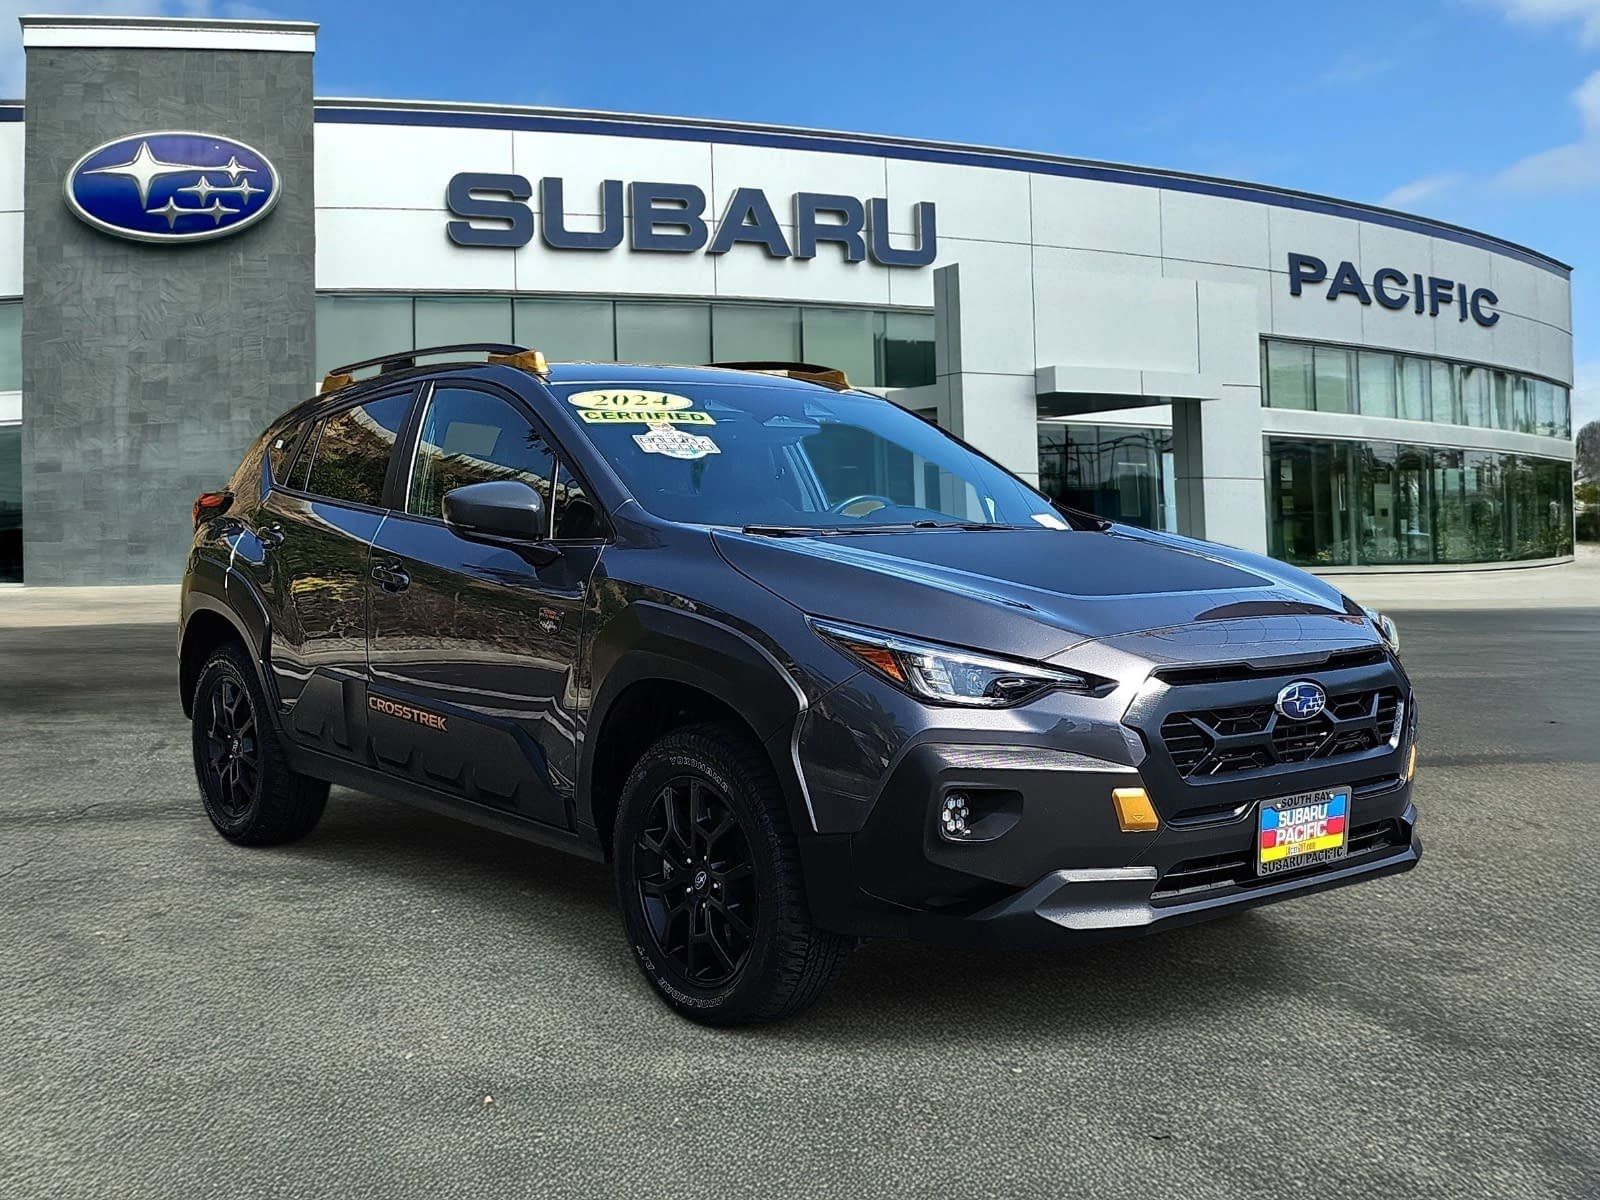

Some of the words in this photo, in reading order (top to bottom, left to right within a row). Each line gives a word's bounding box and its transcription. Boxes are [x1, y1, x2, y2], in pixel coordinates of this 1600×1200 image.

[446, 171, 937, 267] SUBARU
[1288, 252, 1500, 327] PACIFIC
[594, 394, 669, 407] 2024
[584, 411, 706, 422] CERTIFIED
[368, 696, 448, 732] CROSSTREK
[1281, 795, 1313, 808] SOUTH
[1314, 790, 1332, 802] BAY
[1278, 803, 1328, 828] SUBARU
[1275, 820, 1328, 846] PACIFIC
[1261, 854, 1304, 875] SUBARU
[1306, 847, 1344, 864] PACIFIC
